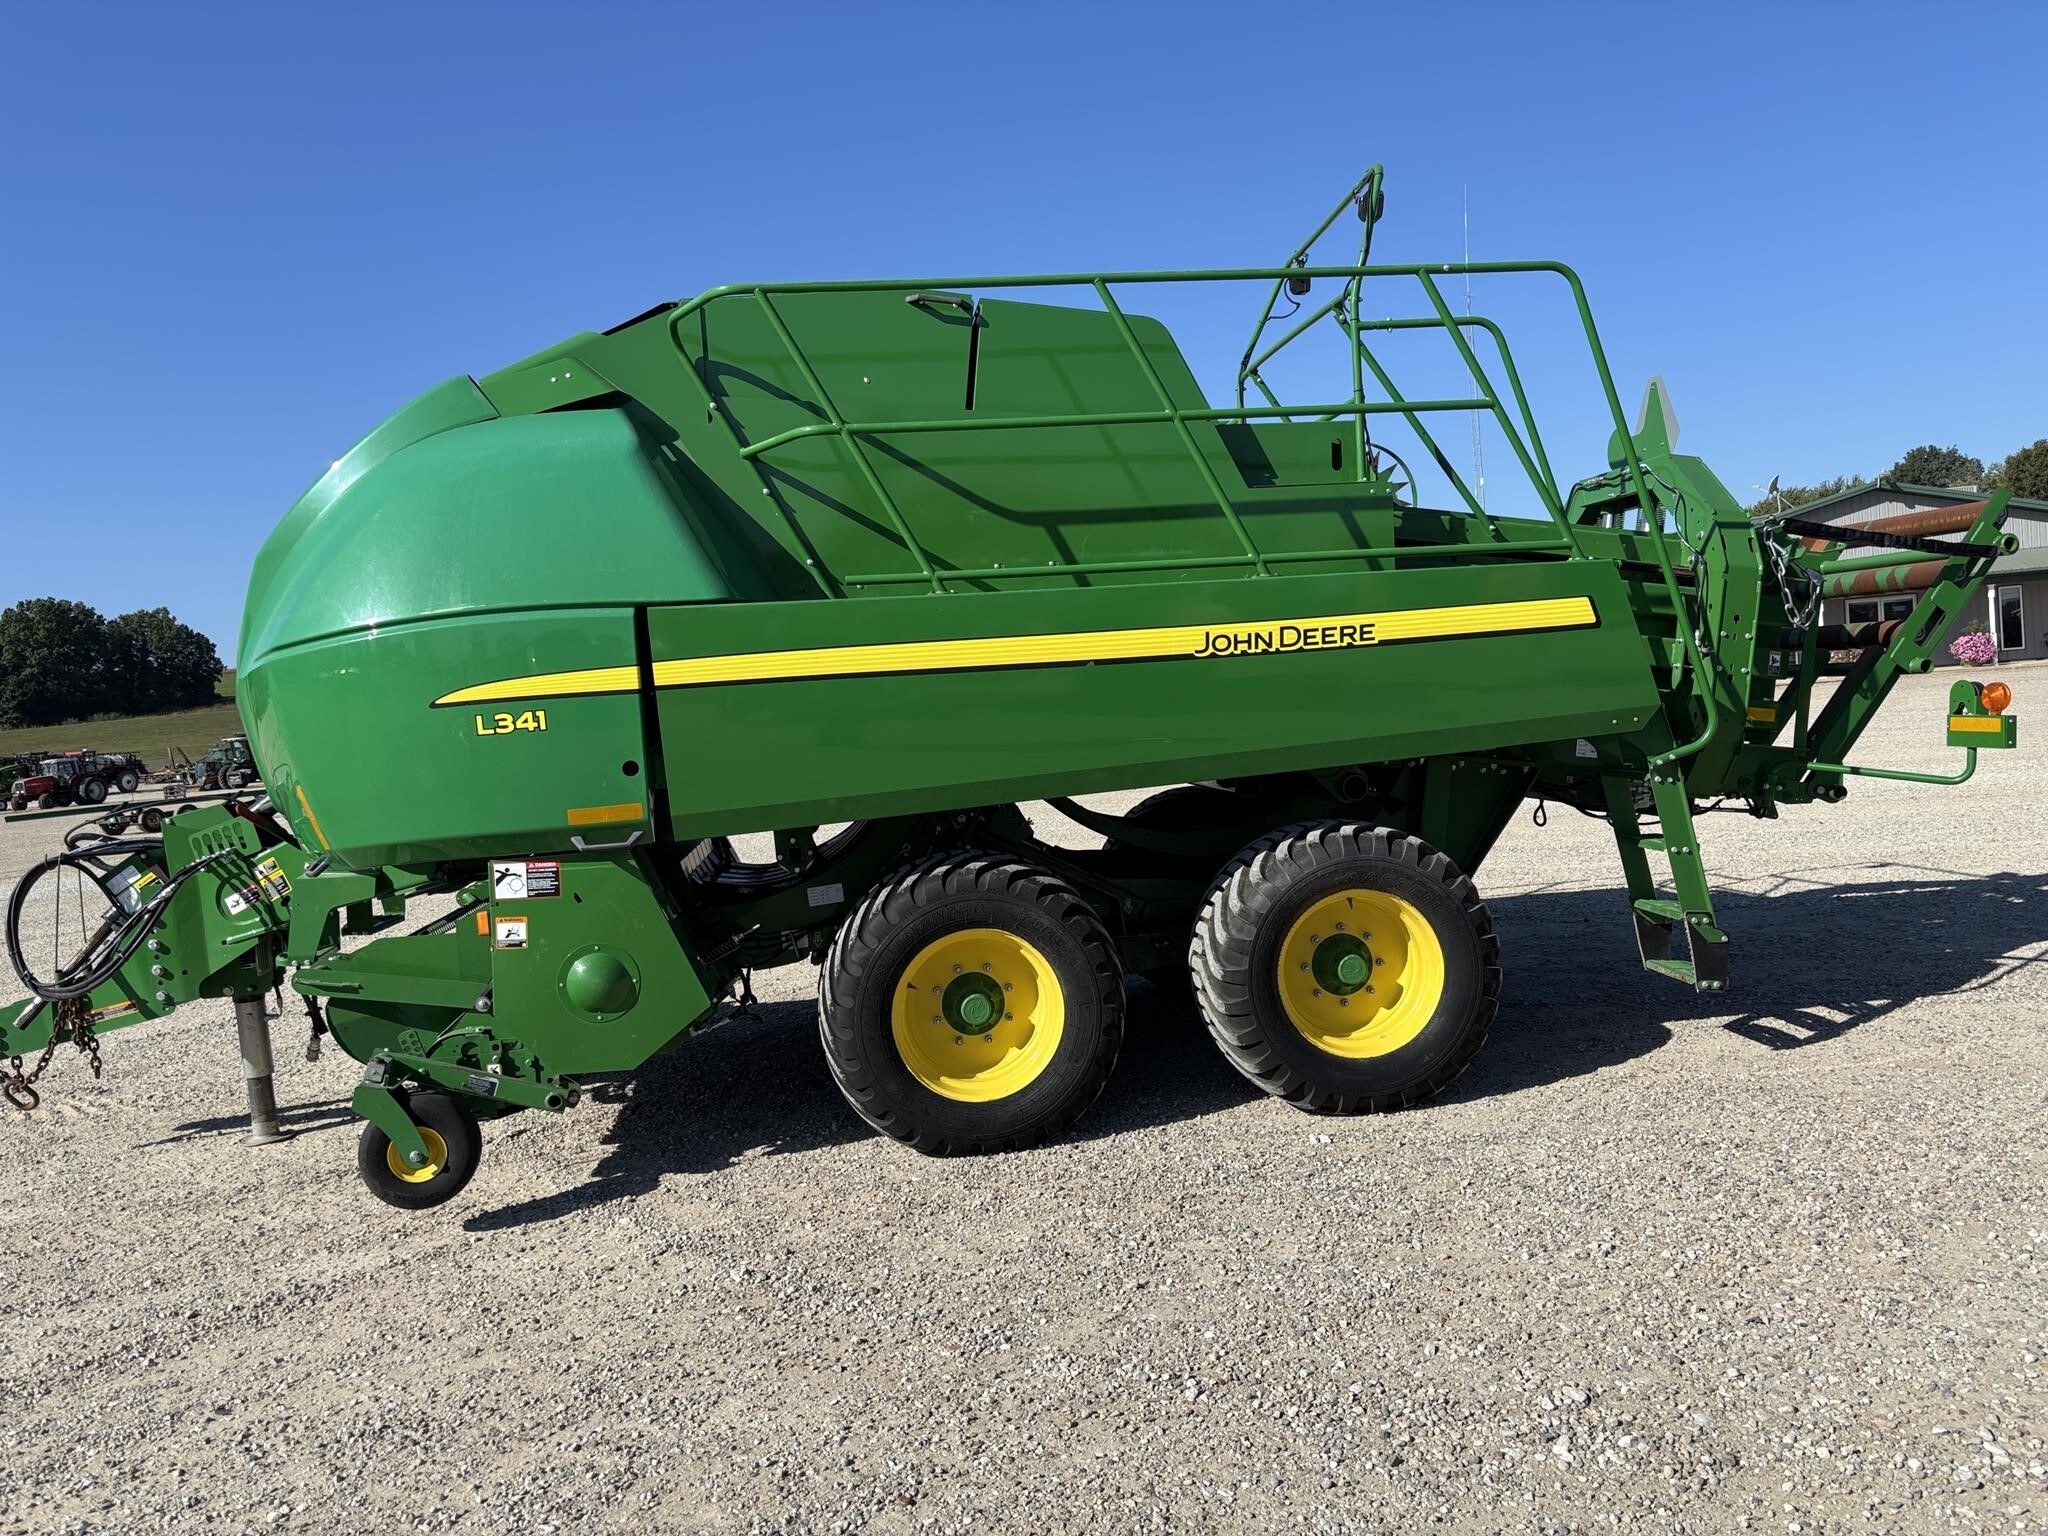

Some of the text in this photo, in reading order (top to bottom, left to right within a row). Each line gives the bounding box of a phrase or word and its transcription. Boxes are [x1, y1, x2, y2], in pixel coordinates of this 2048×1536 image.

[1194, 623, 1376, 655] JOHN DEERE
[475, 710, 547, 736] L341
